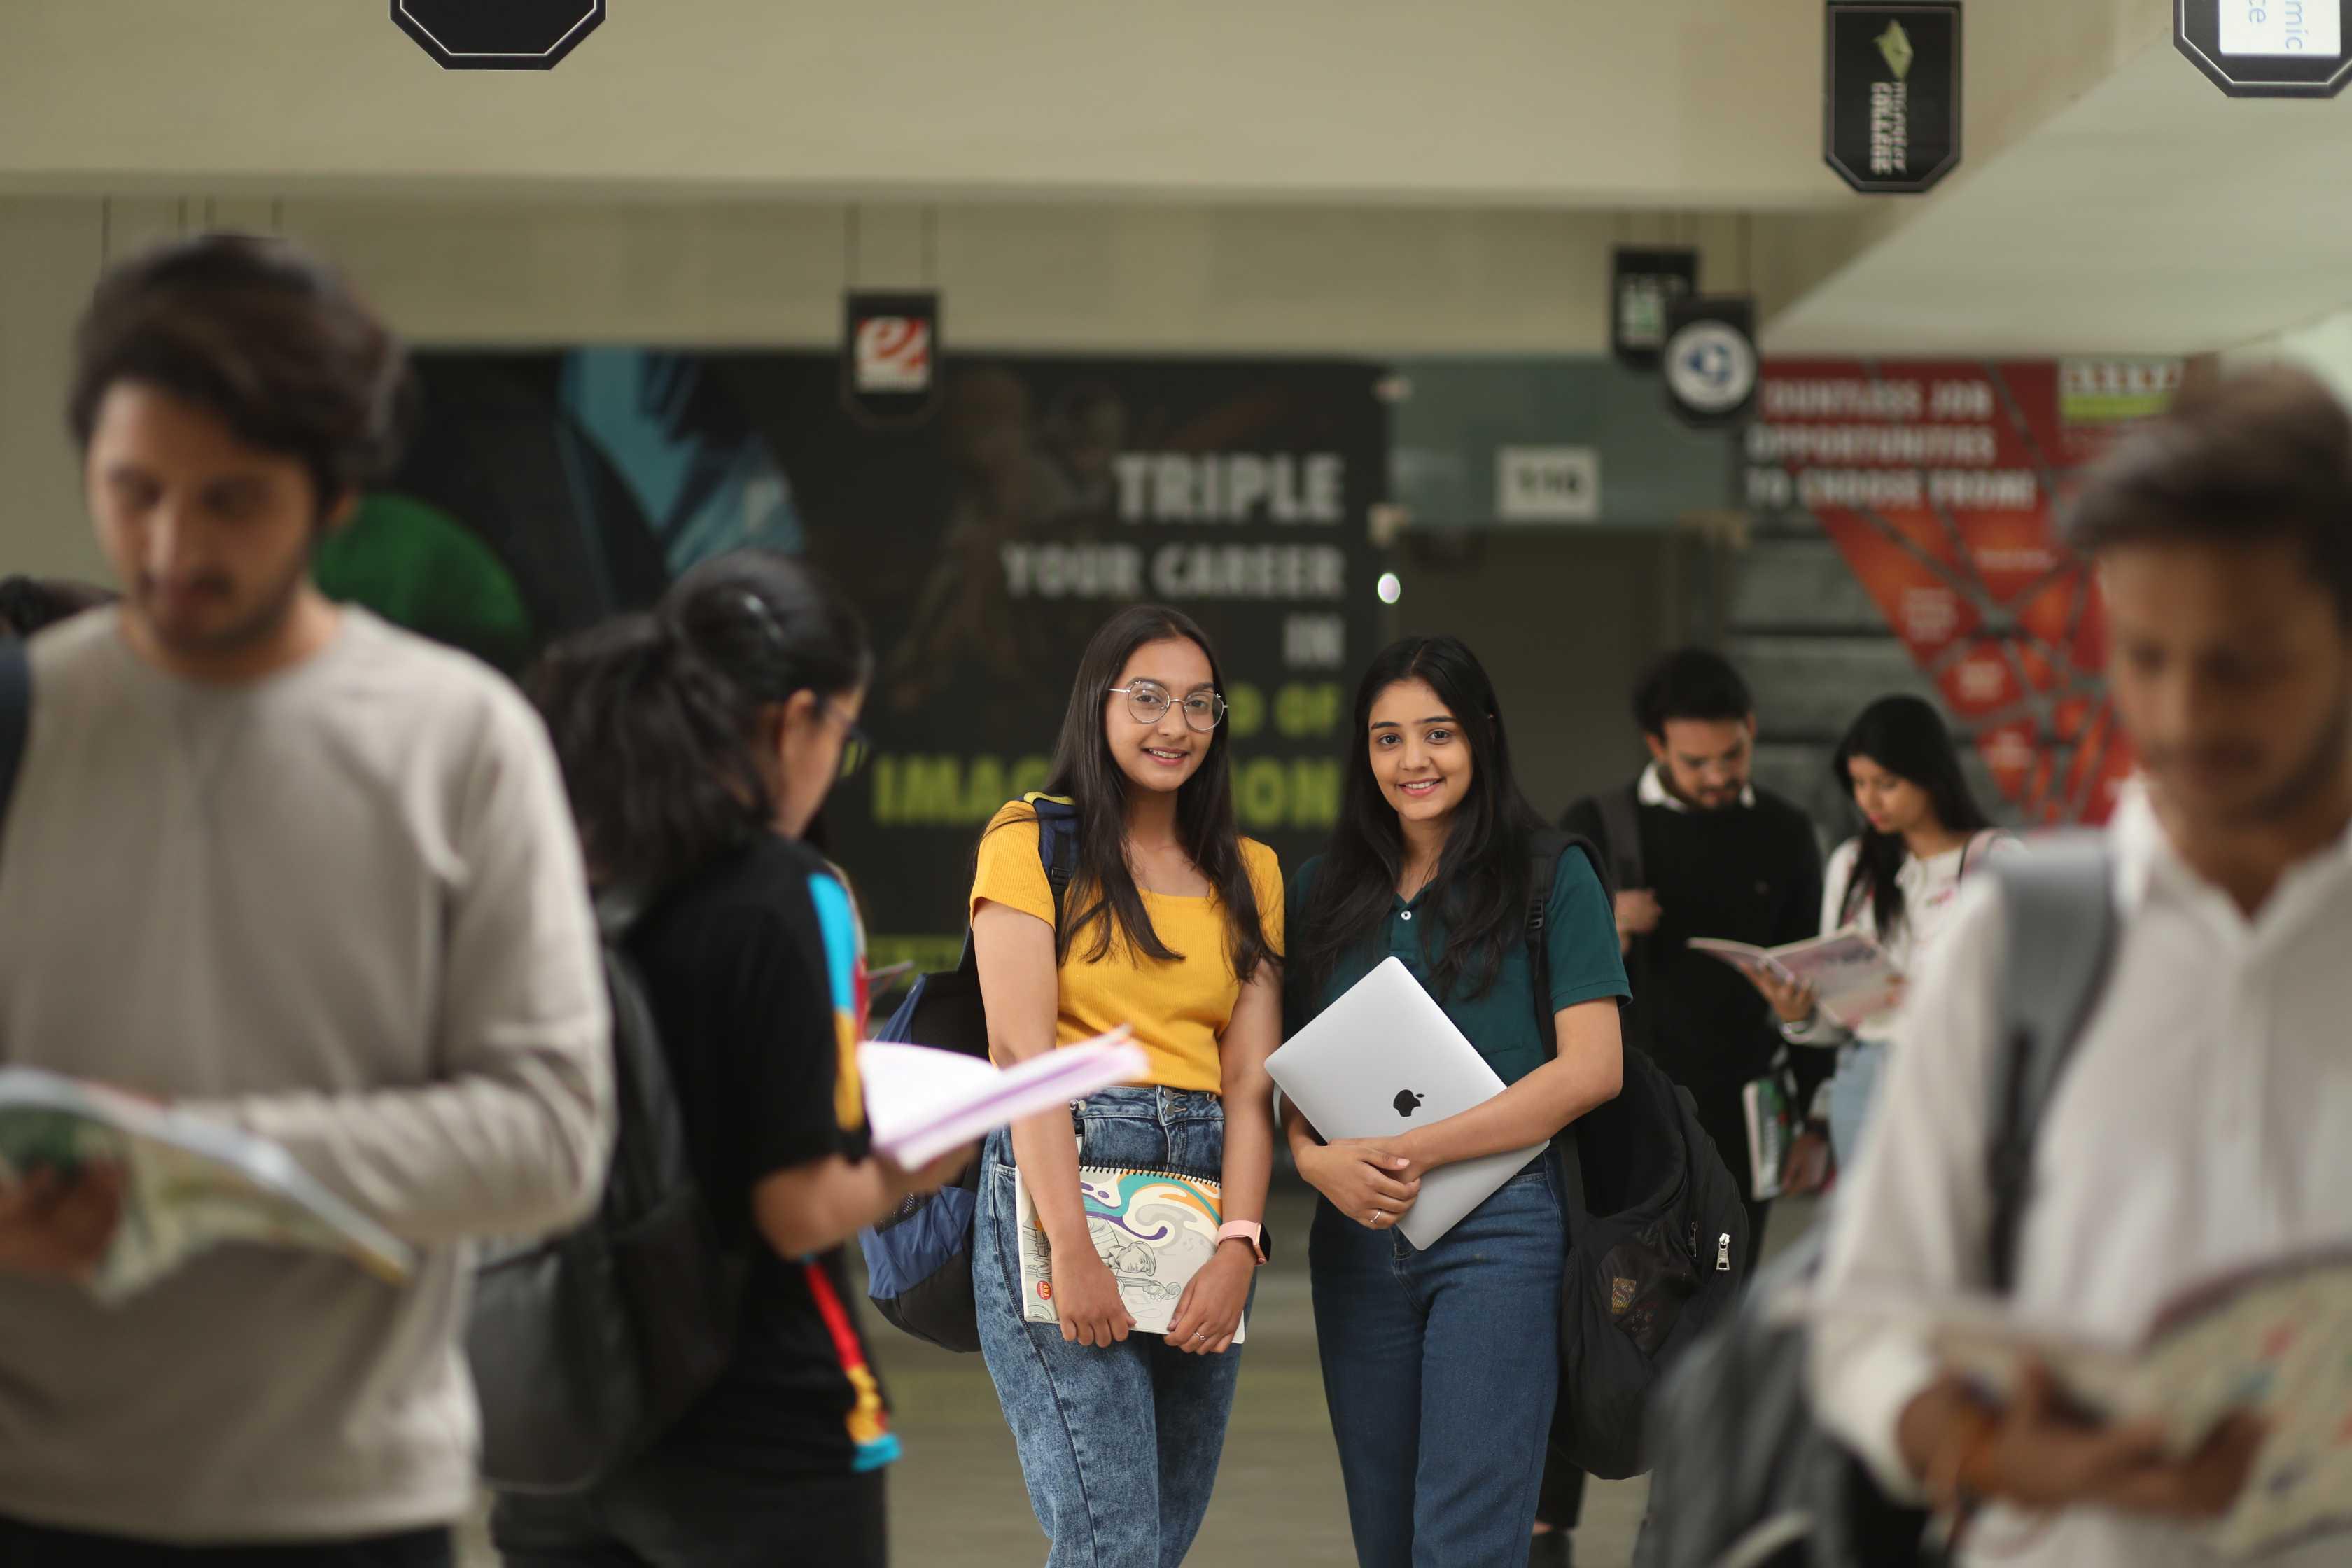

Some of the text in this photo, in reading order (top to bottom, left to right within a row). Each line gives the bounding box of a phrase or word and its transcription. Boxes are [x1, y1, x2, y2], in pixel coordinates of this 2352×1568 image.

[1931, 380, 1992, 419] JOB
[1749, 424, 1996, 462] OPPORTUNITIES
[1115, 453, 1343, 523] TRIPLE
[1748, 468, 1791, 508] TO
[1798, 468, 1919, 508] CHOOSE
[1004, 544, 1345, 598] YOUR CAREER
[1285, 615, 1345, 666] IN
[1275, 682, 1340, 734] OF
